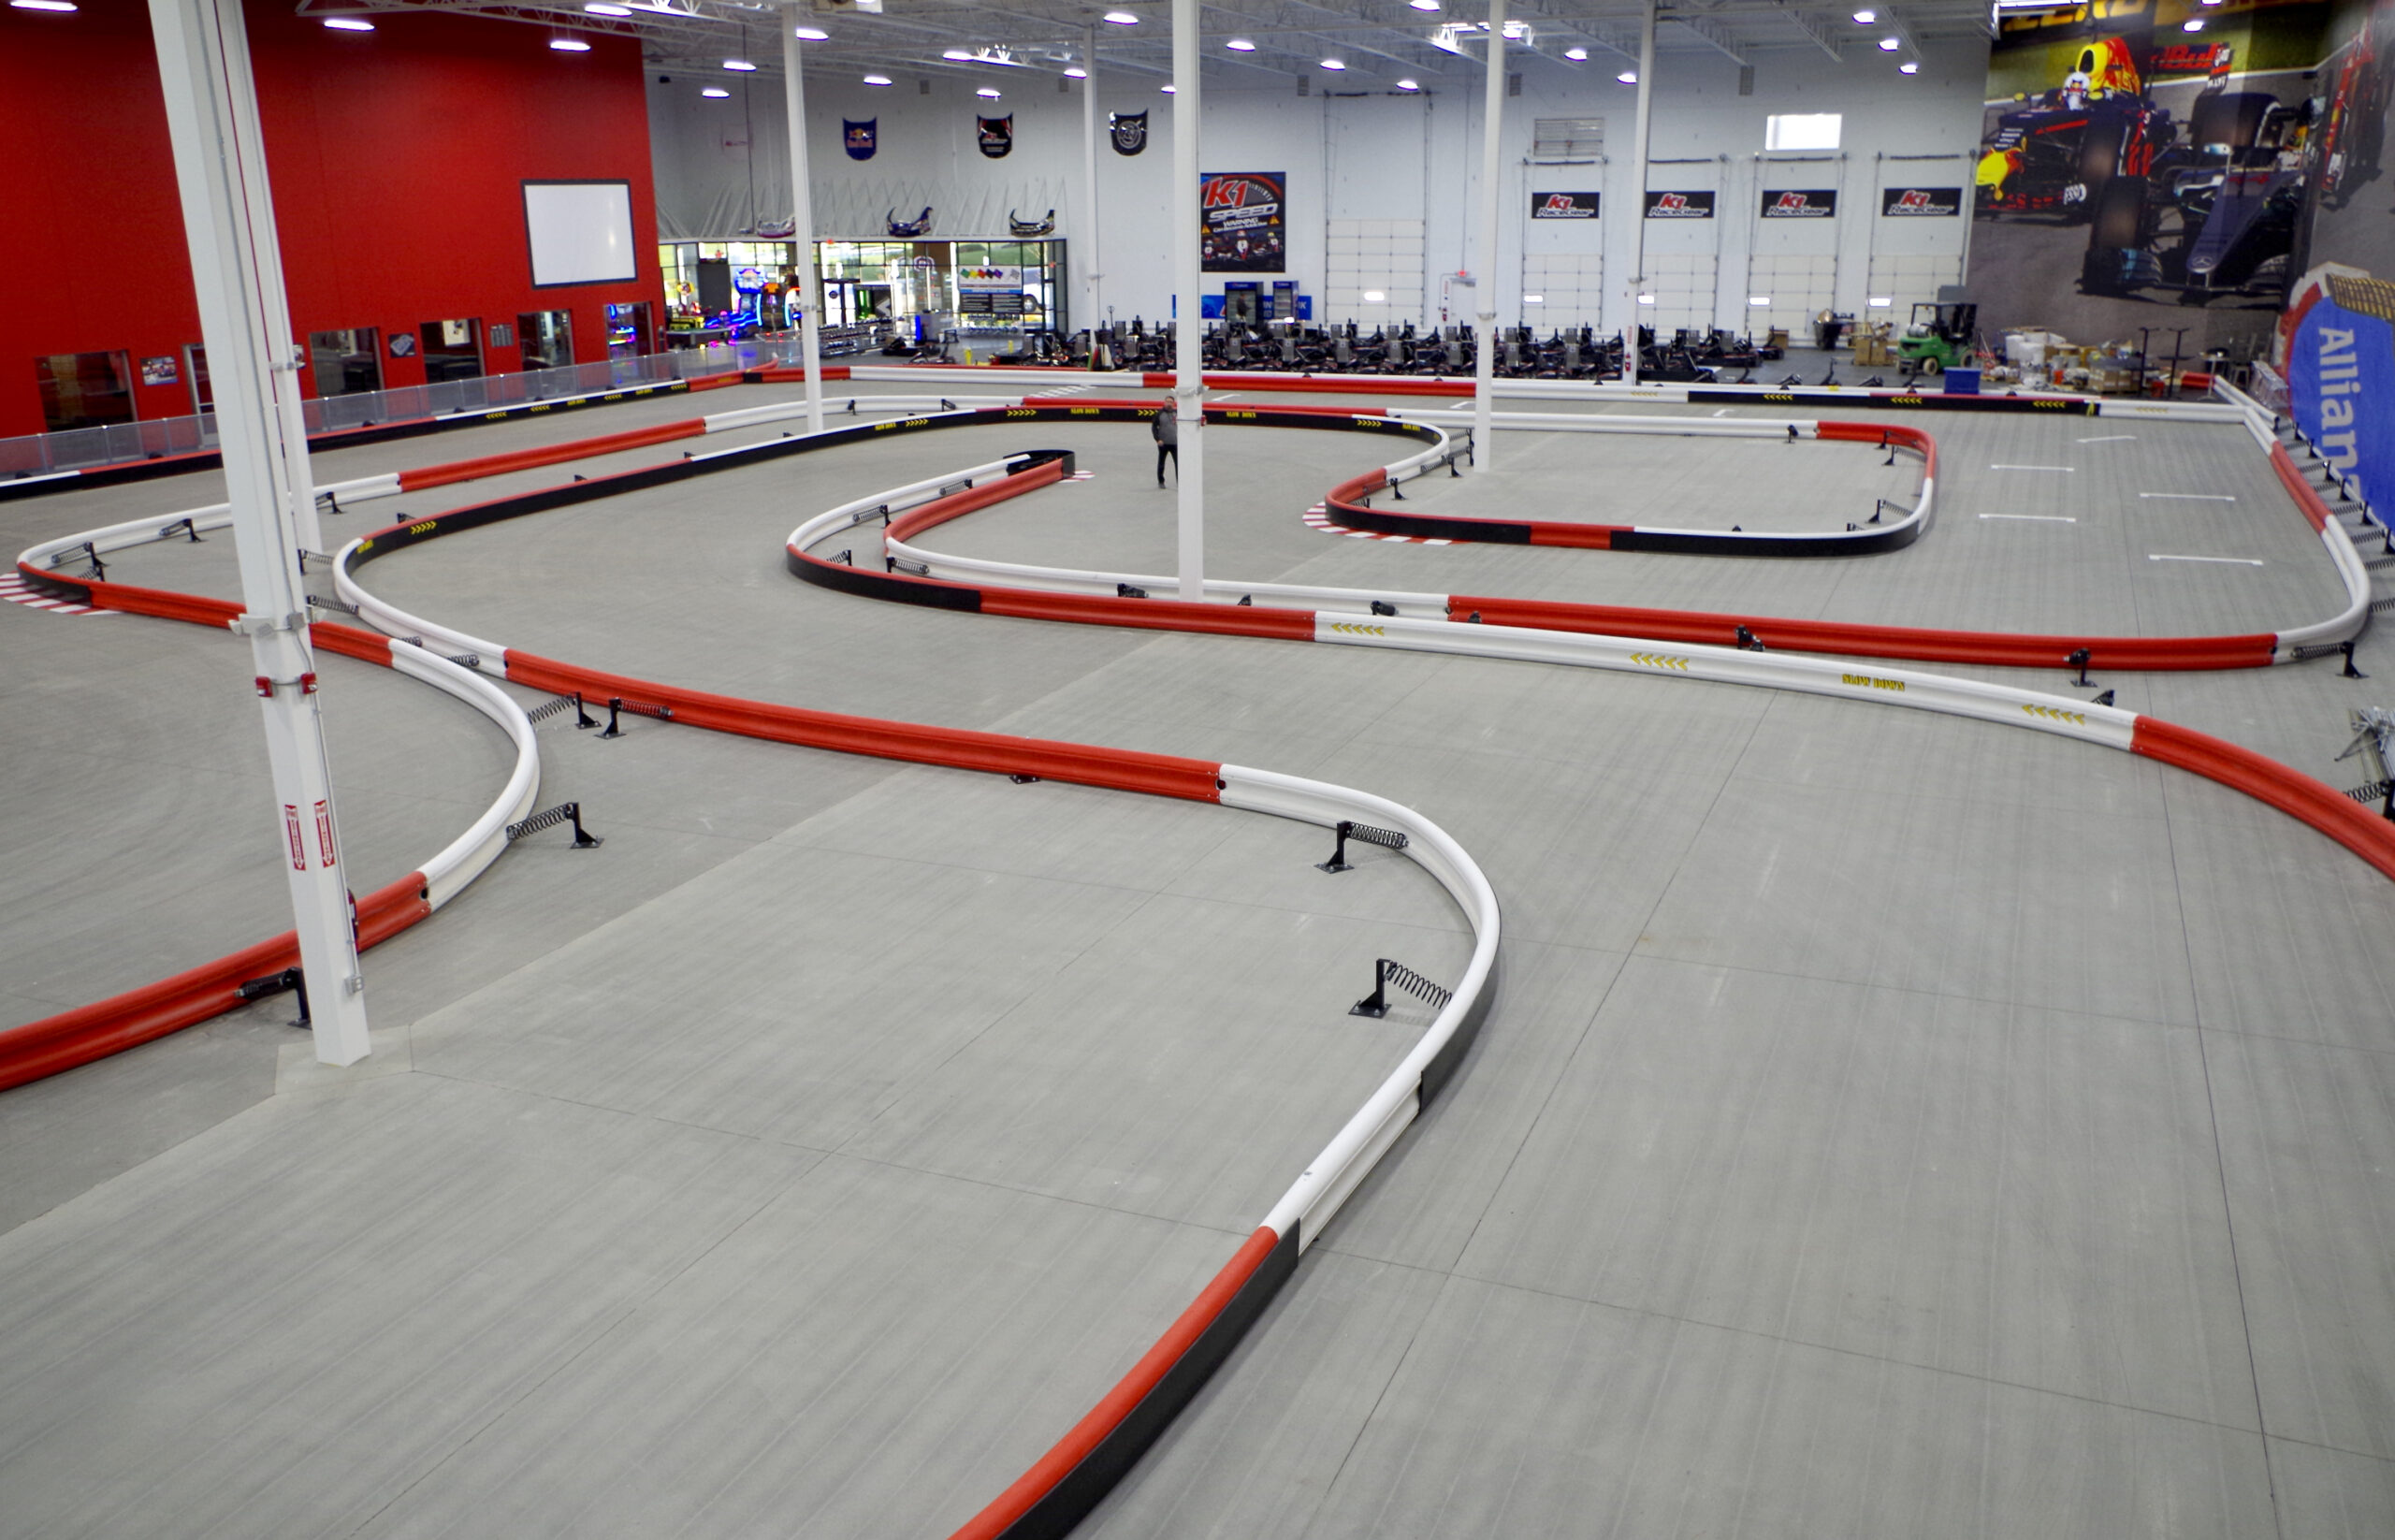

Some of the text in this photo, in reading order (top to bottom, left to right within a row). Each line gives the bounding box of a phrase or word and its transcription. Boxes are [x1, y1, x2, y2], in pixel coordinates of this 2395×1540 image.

[1204, 177, 1249, 208] K1
[1778, 192, 1807, 210] K1
[1899, 190, 1930, 208] K1
[1546, 194, 1574, 211] K1
[1659, 193, 1687, 211] K1
[1208, 202, 1278, 223] SPEED
[1842, 674, 1906, 691] SLOW DOWN
